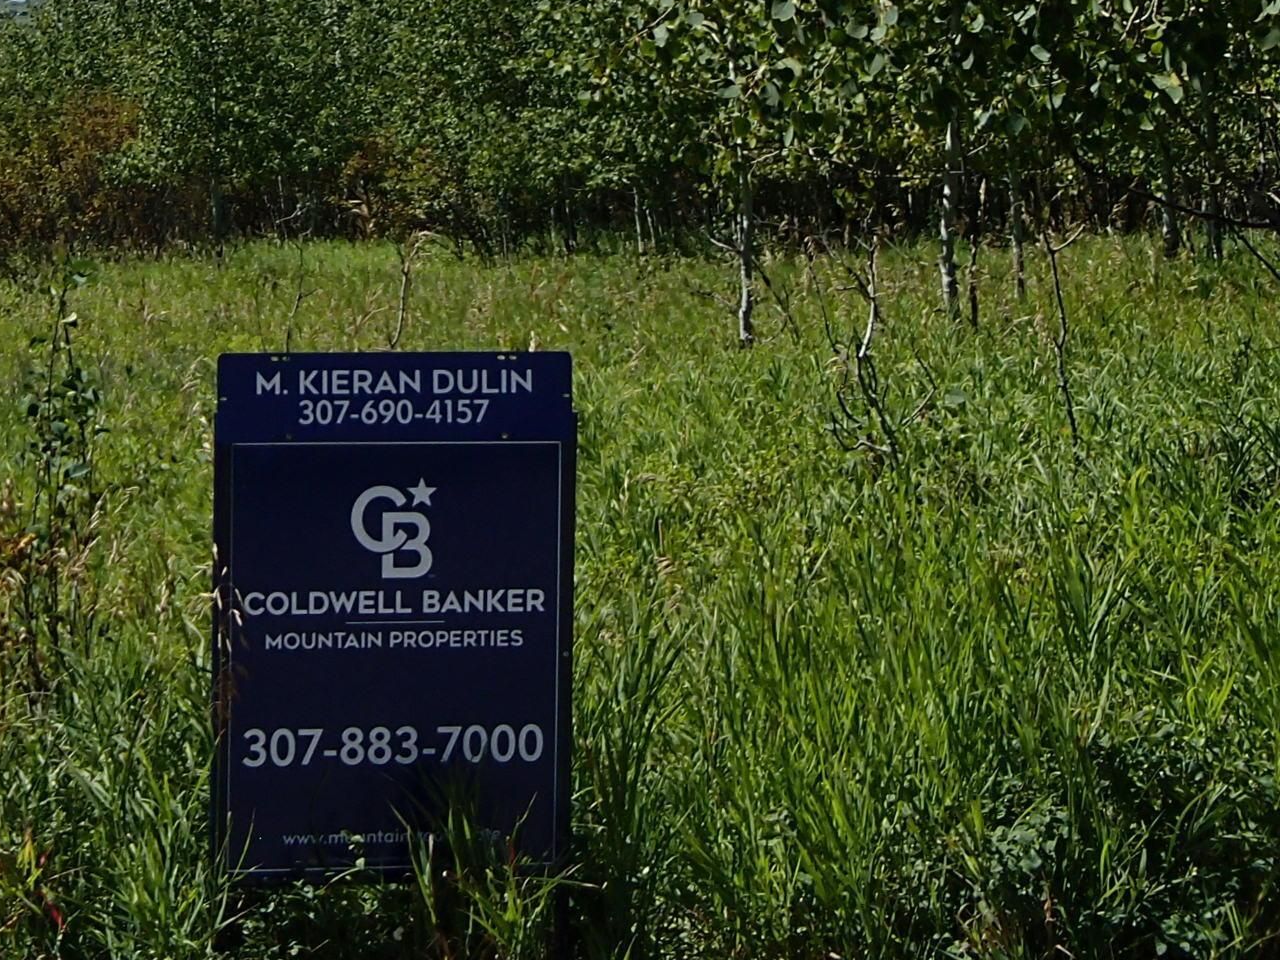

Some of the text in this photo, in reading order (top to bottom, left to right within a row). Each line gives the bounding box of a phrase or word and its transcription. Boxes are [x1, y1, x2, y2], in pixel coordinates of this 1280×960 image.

[256, 368, 533, 395] M. KIERAN DULIN
[298, 399, 490, 425] 307-690-4157
[244, 589, 545, 616] COLDWELL BANKER
[265, 629, 524, 650] MOUNTAIN PROPERTIES
[242, 724, 544, 767] 307-883-7000
